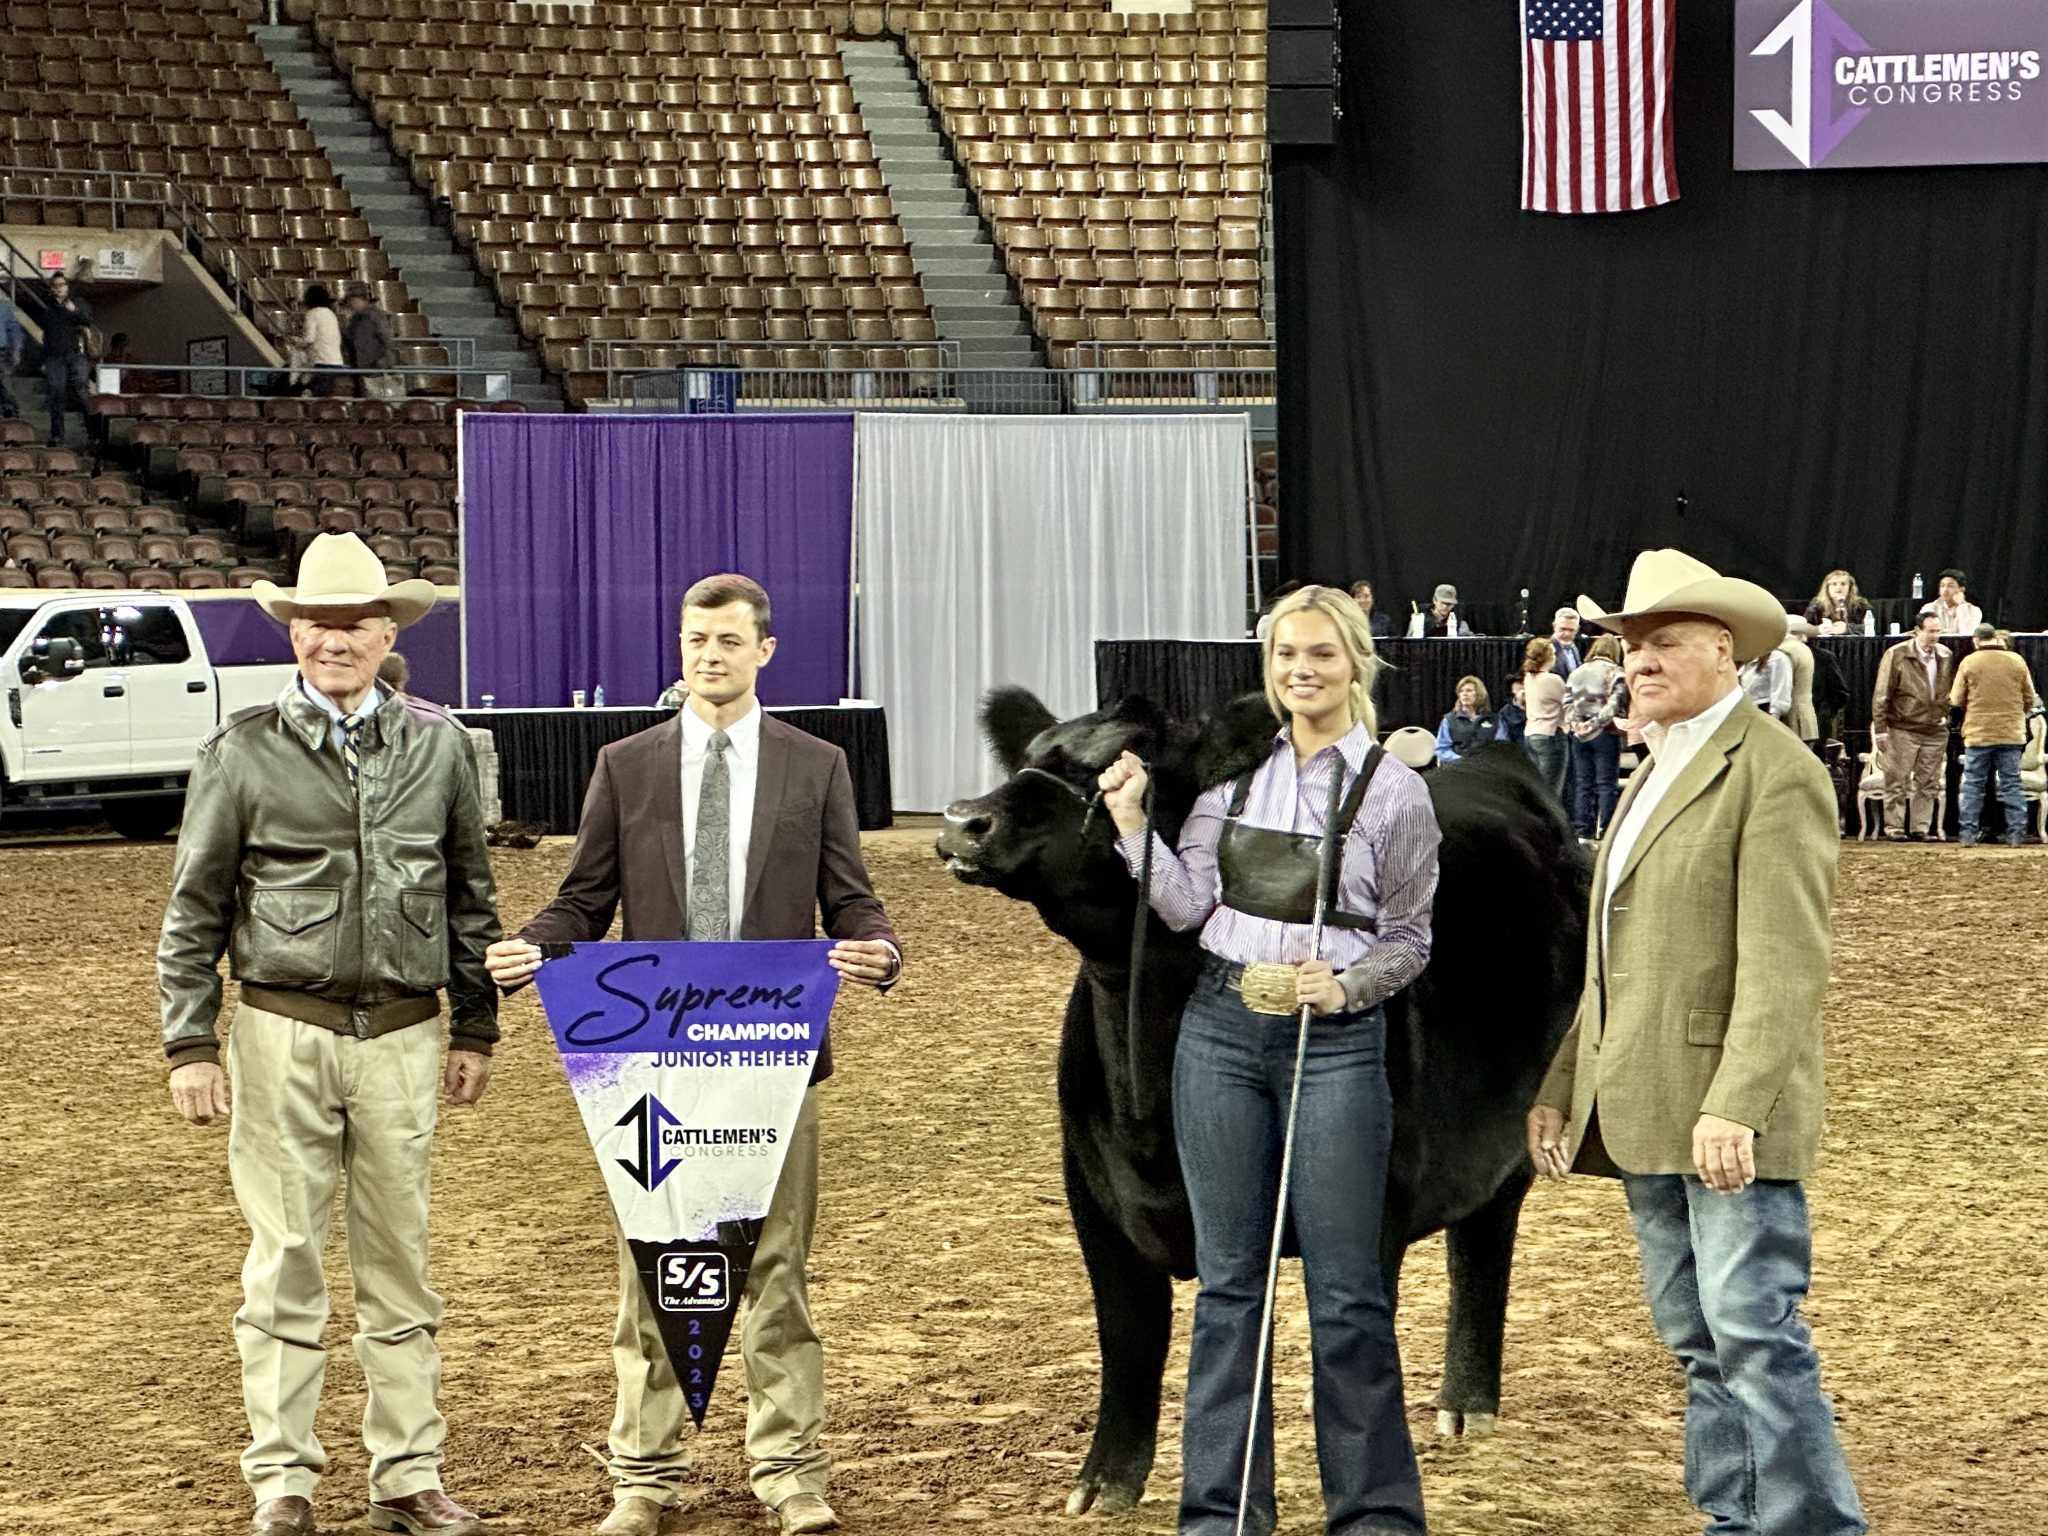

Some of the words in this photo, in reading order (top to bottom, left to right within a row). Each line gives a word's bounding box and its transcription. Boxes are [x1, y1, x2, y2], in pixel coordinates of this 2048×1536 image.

[1835, 51, 2040, 84] CATTLEMEN'S
[1849, 81, 2022, 105] CONGRESS
[565, 954, 804, 1046] Supreme
[687, 1023, 810, 1041] CHAMPION
[651, 1051, 732, 1068] JUNIOR
[739, 1051, 809, 1067] HEIFER
[662, 1128, 777, 1145] CATTLEMEN'S
[670, 1145, 769, 1158] CONGRESS
[664, 1257, 720, 1296] S/S
[664, 1296, 680, 1305] The
[680, 1296, 725, 1306] Advantage
[688, 1320, 703, 1408] 2023
